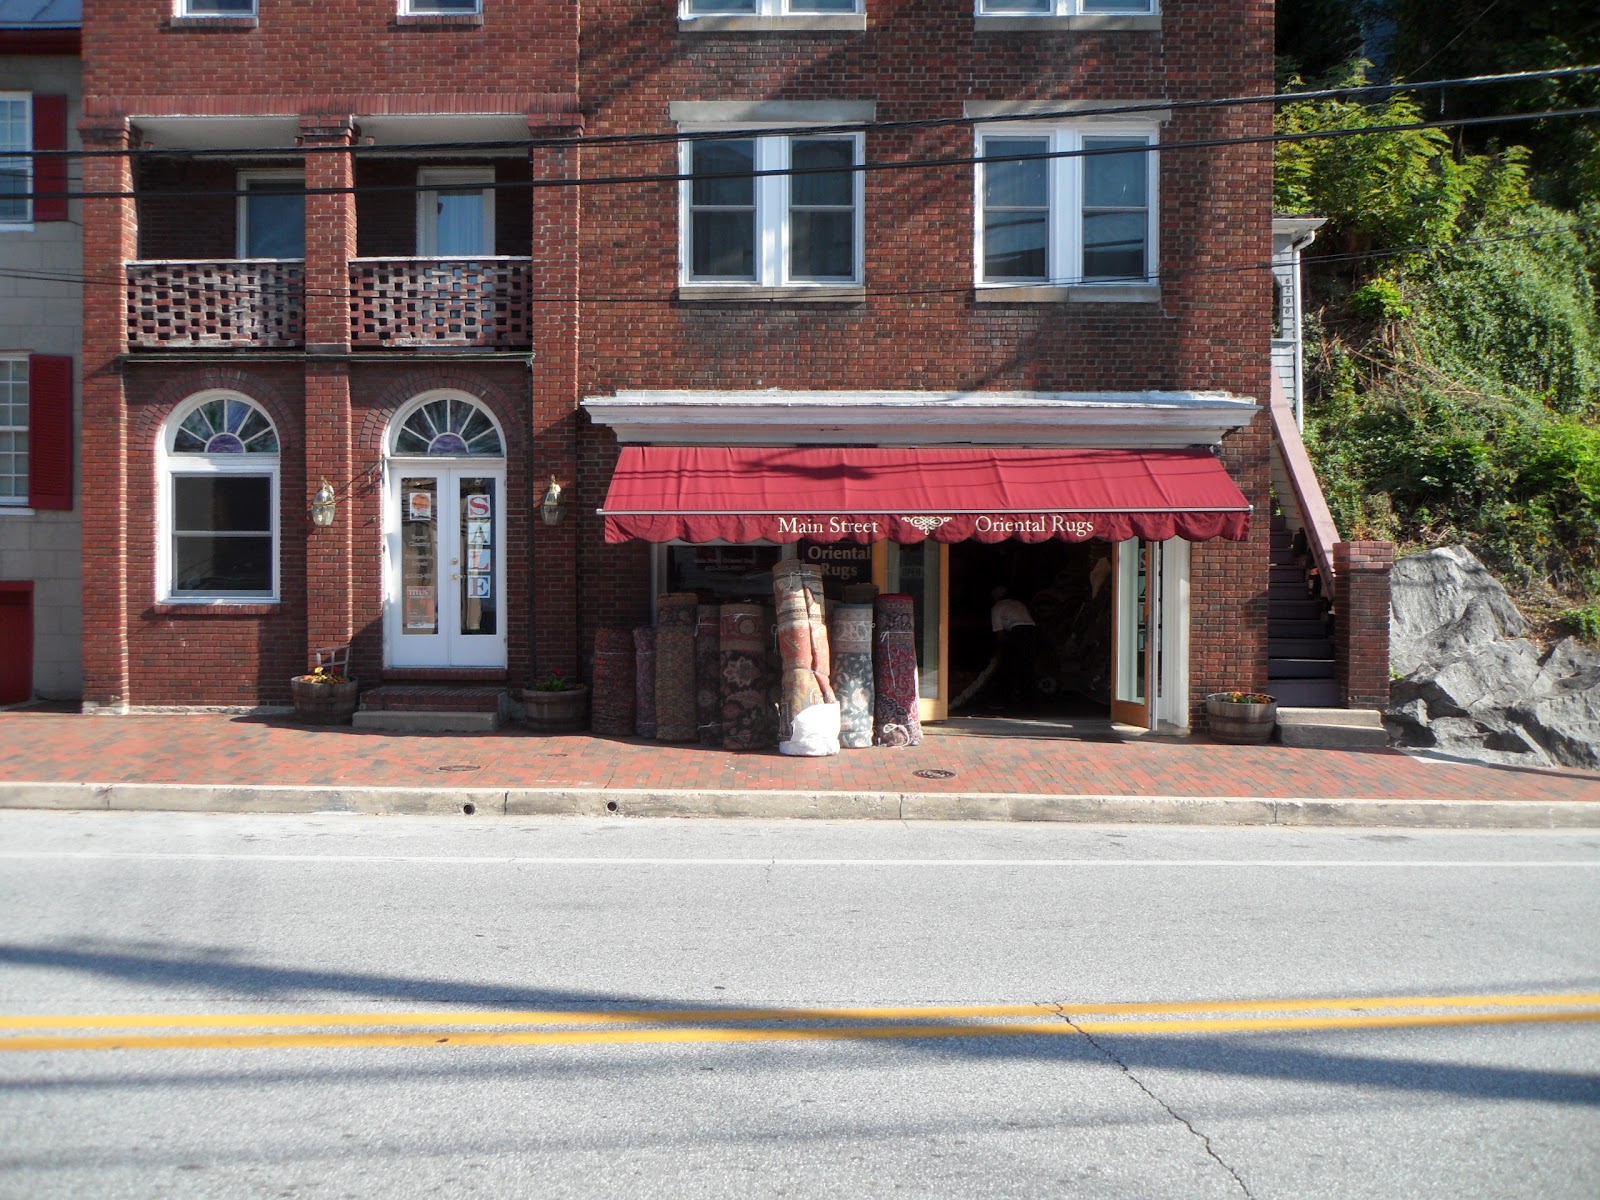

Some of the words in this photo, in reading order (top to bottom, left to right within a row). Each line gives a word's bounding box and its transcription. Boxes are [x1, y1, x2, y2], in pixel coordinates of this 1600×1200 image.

[777, 517, 824, 533] Main
[829, 516, 879, 533] Street
[975, 515, 1046, 532] Oriental
[1051, 515, 1094, 537] Rugs
[469, 496, 490, 597] SALE
[807, 545, 871, 560] Oriental
[820, 563, 858, 580] Rugs
